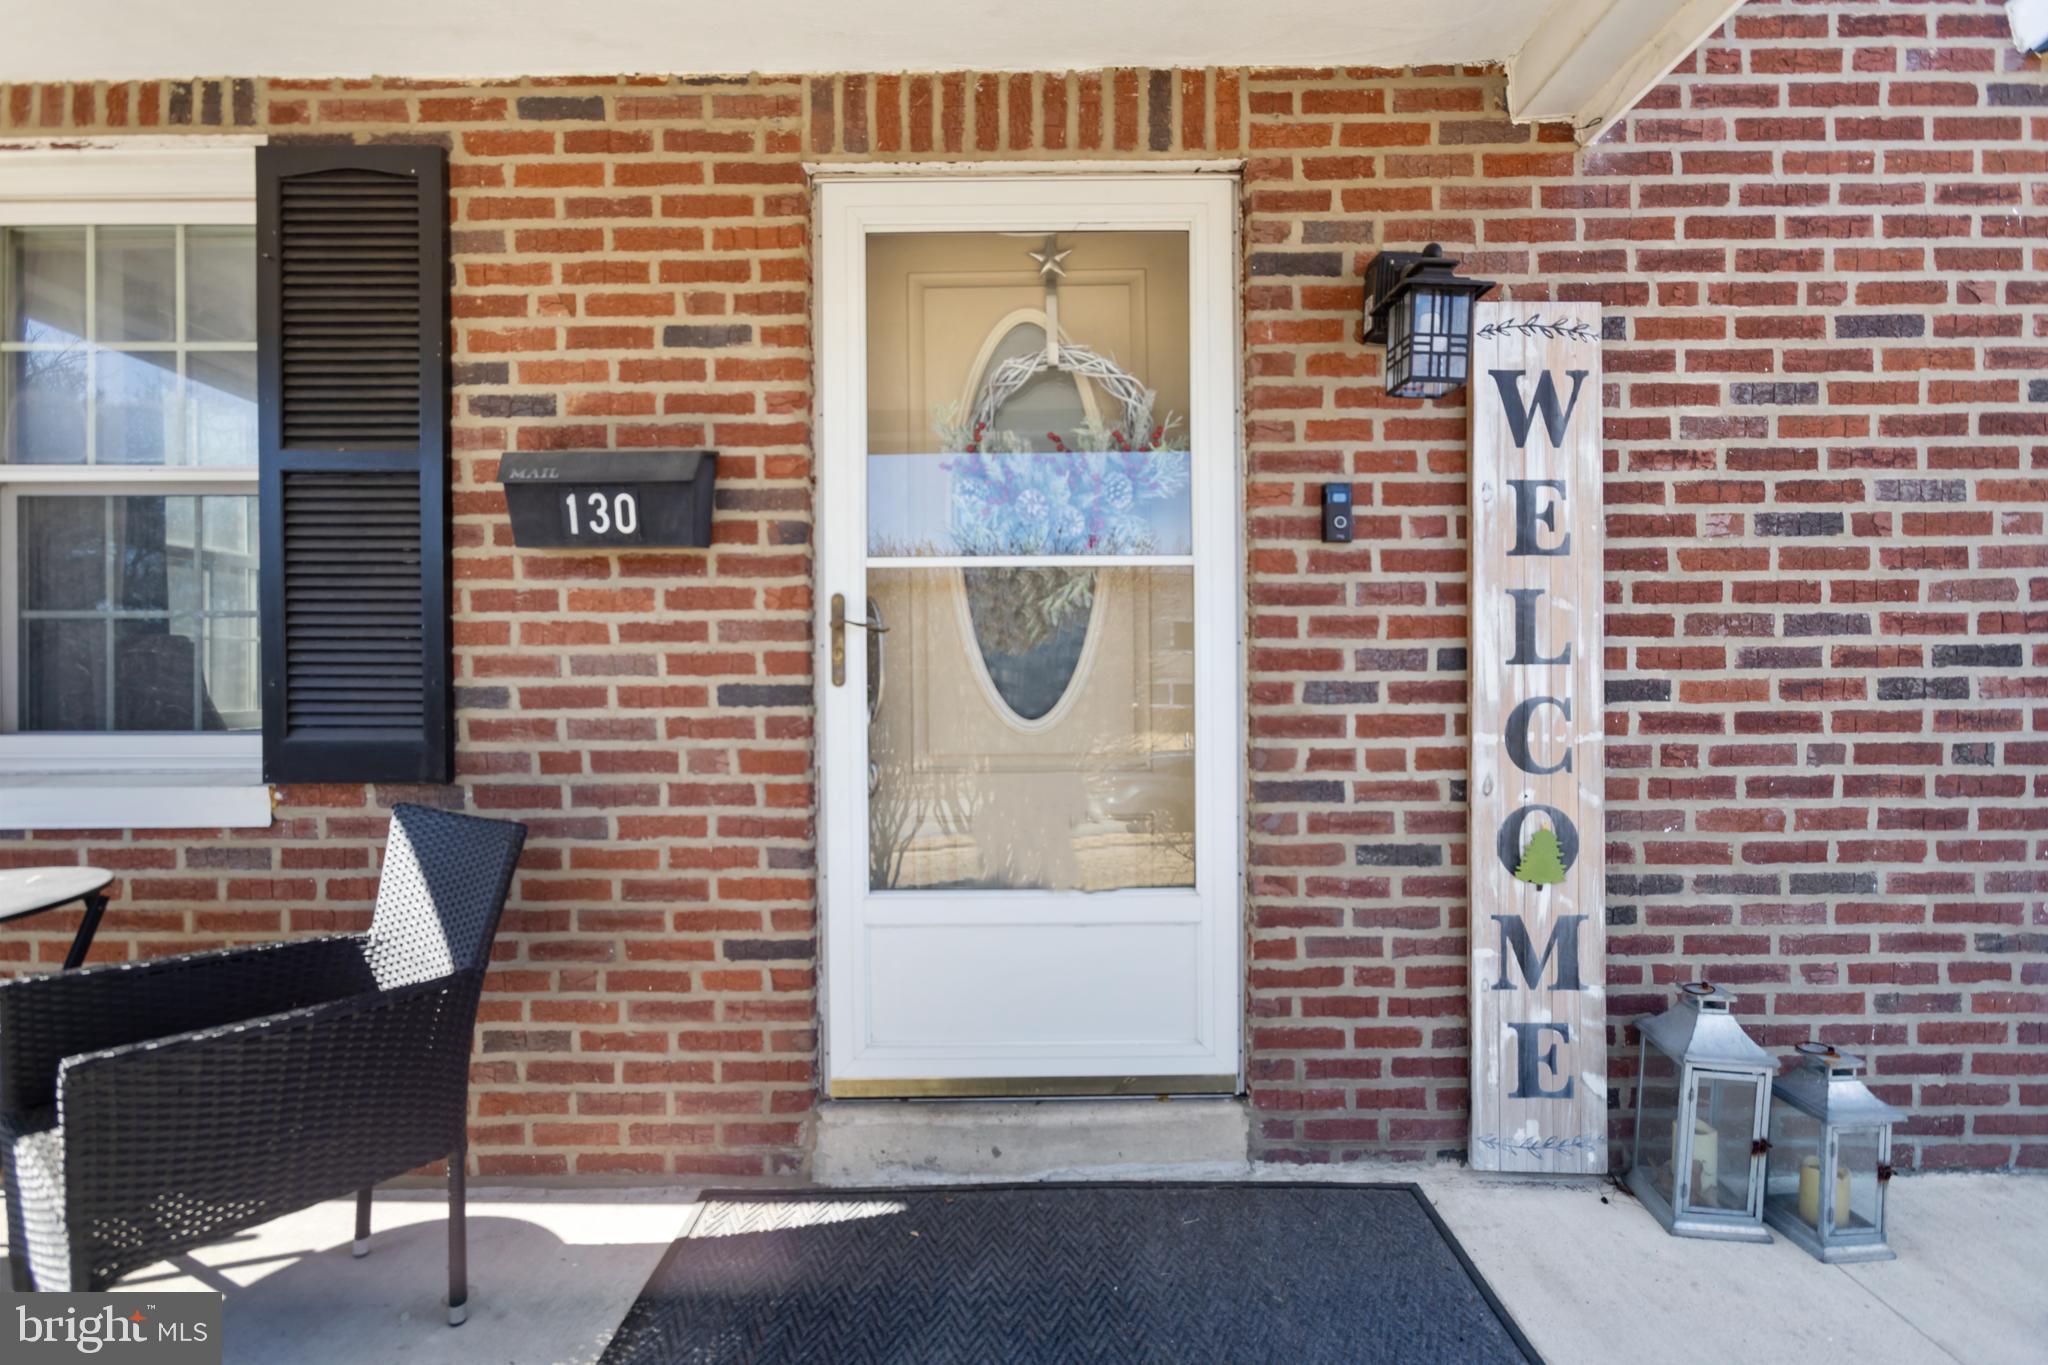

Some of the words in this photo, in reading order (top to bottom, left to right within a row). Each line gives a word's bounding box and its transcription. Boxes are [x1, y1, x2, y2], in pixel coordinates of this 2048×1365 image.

[509, 467, 559, 479] MAIL
[566, 492, 637, 535] 130
[1488, 369, 1590, 1099] WELCOME
